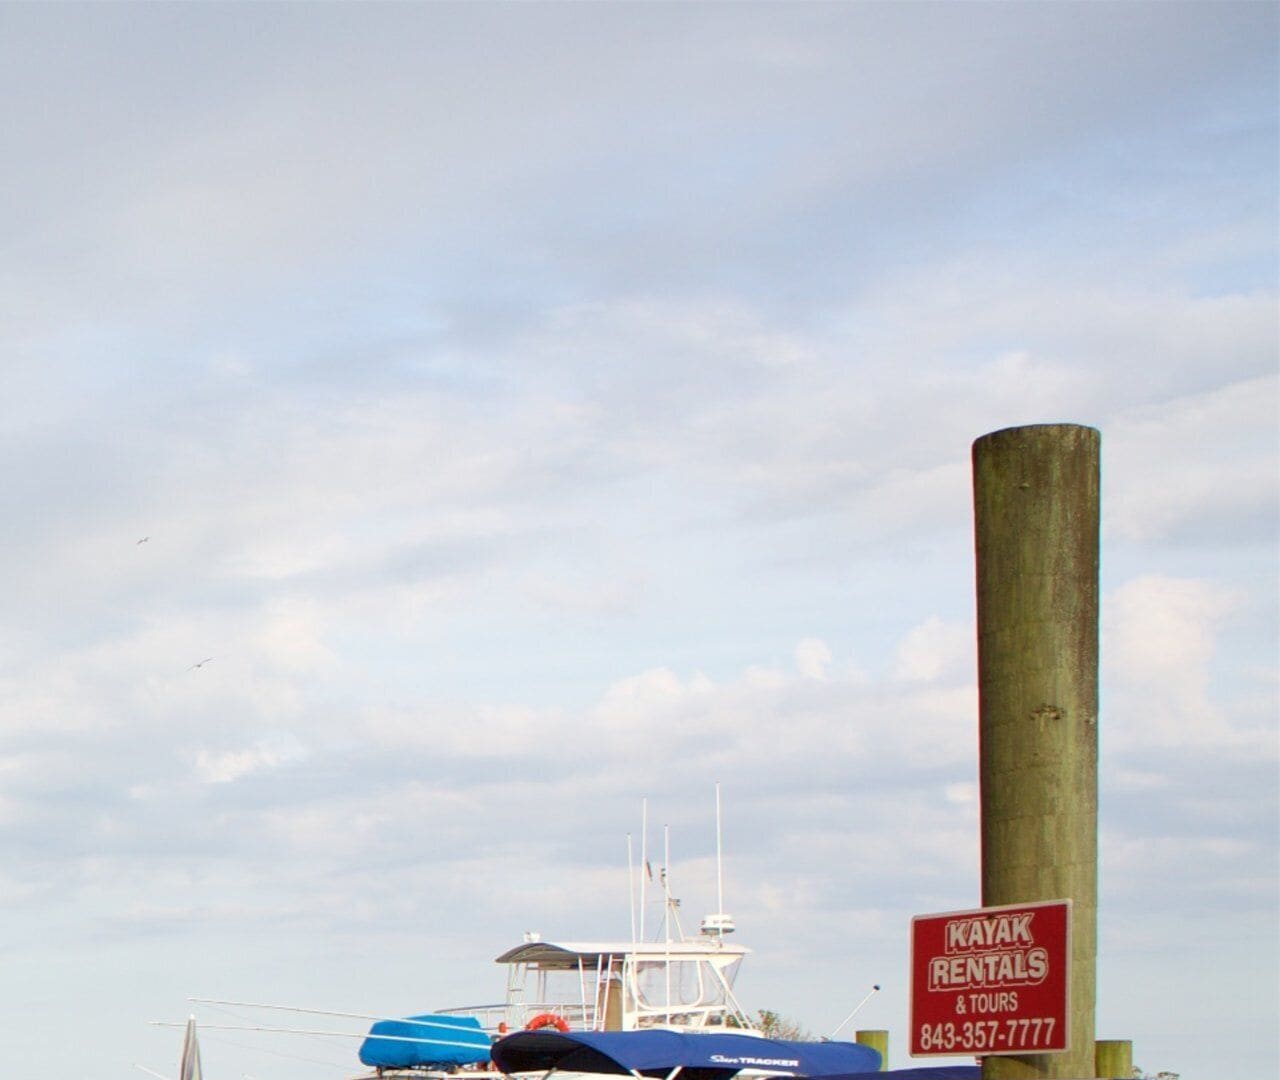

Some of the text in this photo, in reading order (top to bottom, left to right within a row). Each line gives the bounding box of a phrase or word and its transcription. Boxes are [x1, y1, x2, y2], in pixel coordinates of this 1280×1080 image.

[946, 914, 1034, 953] KAYAK
[929, 949, 1048, 990] RENTALS
[955, 992, 1018, 1014] & TOURS
[920, 1018, 1055, 1050] 843-357-7777
